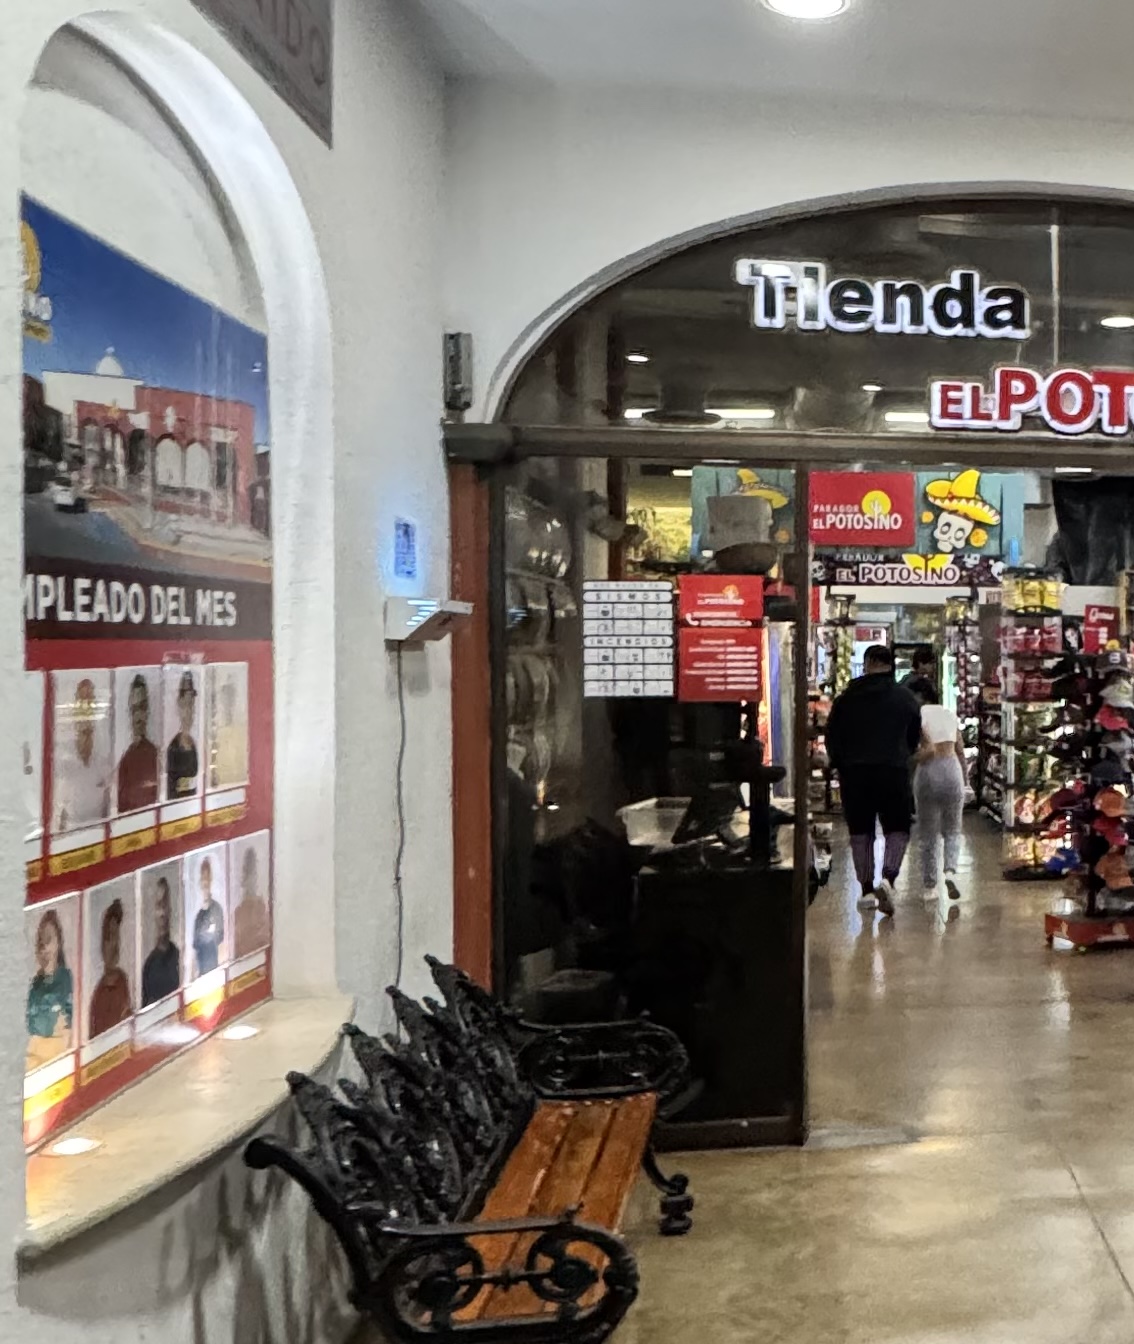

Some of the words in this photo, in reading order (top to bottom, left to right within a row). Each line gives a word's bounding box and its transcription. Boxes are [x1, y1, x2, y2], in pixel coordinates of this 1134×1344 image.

[737, 258, 1030, 339] Tienda
[934, 382, 993, 429] EL
[812, 519, 825, 529] EL
[826, 513, 902, 530] POTOSINO
[836, 568, 855, 582] EL
[858, 562, 960, 585] POTOSINO
[150, 584, 192, 625] DEL
[196, 588, 237, 627] MES
